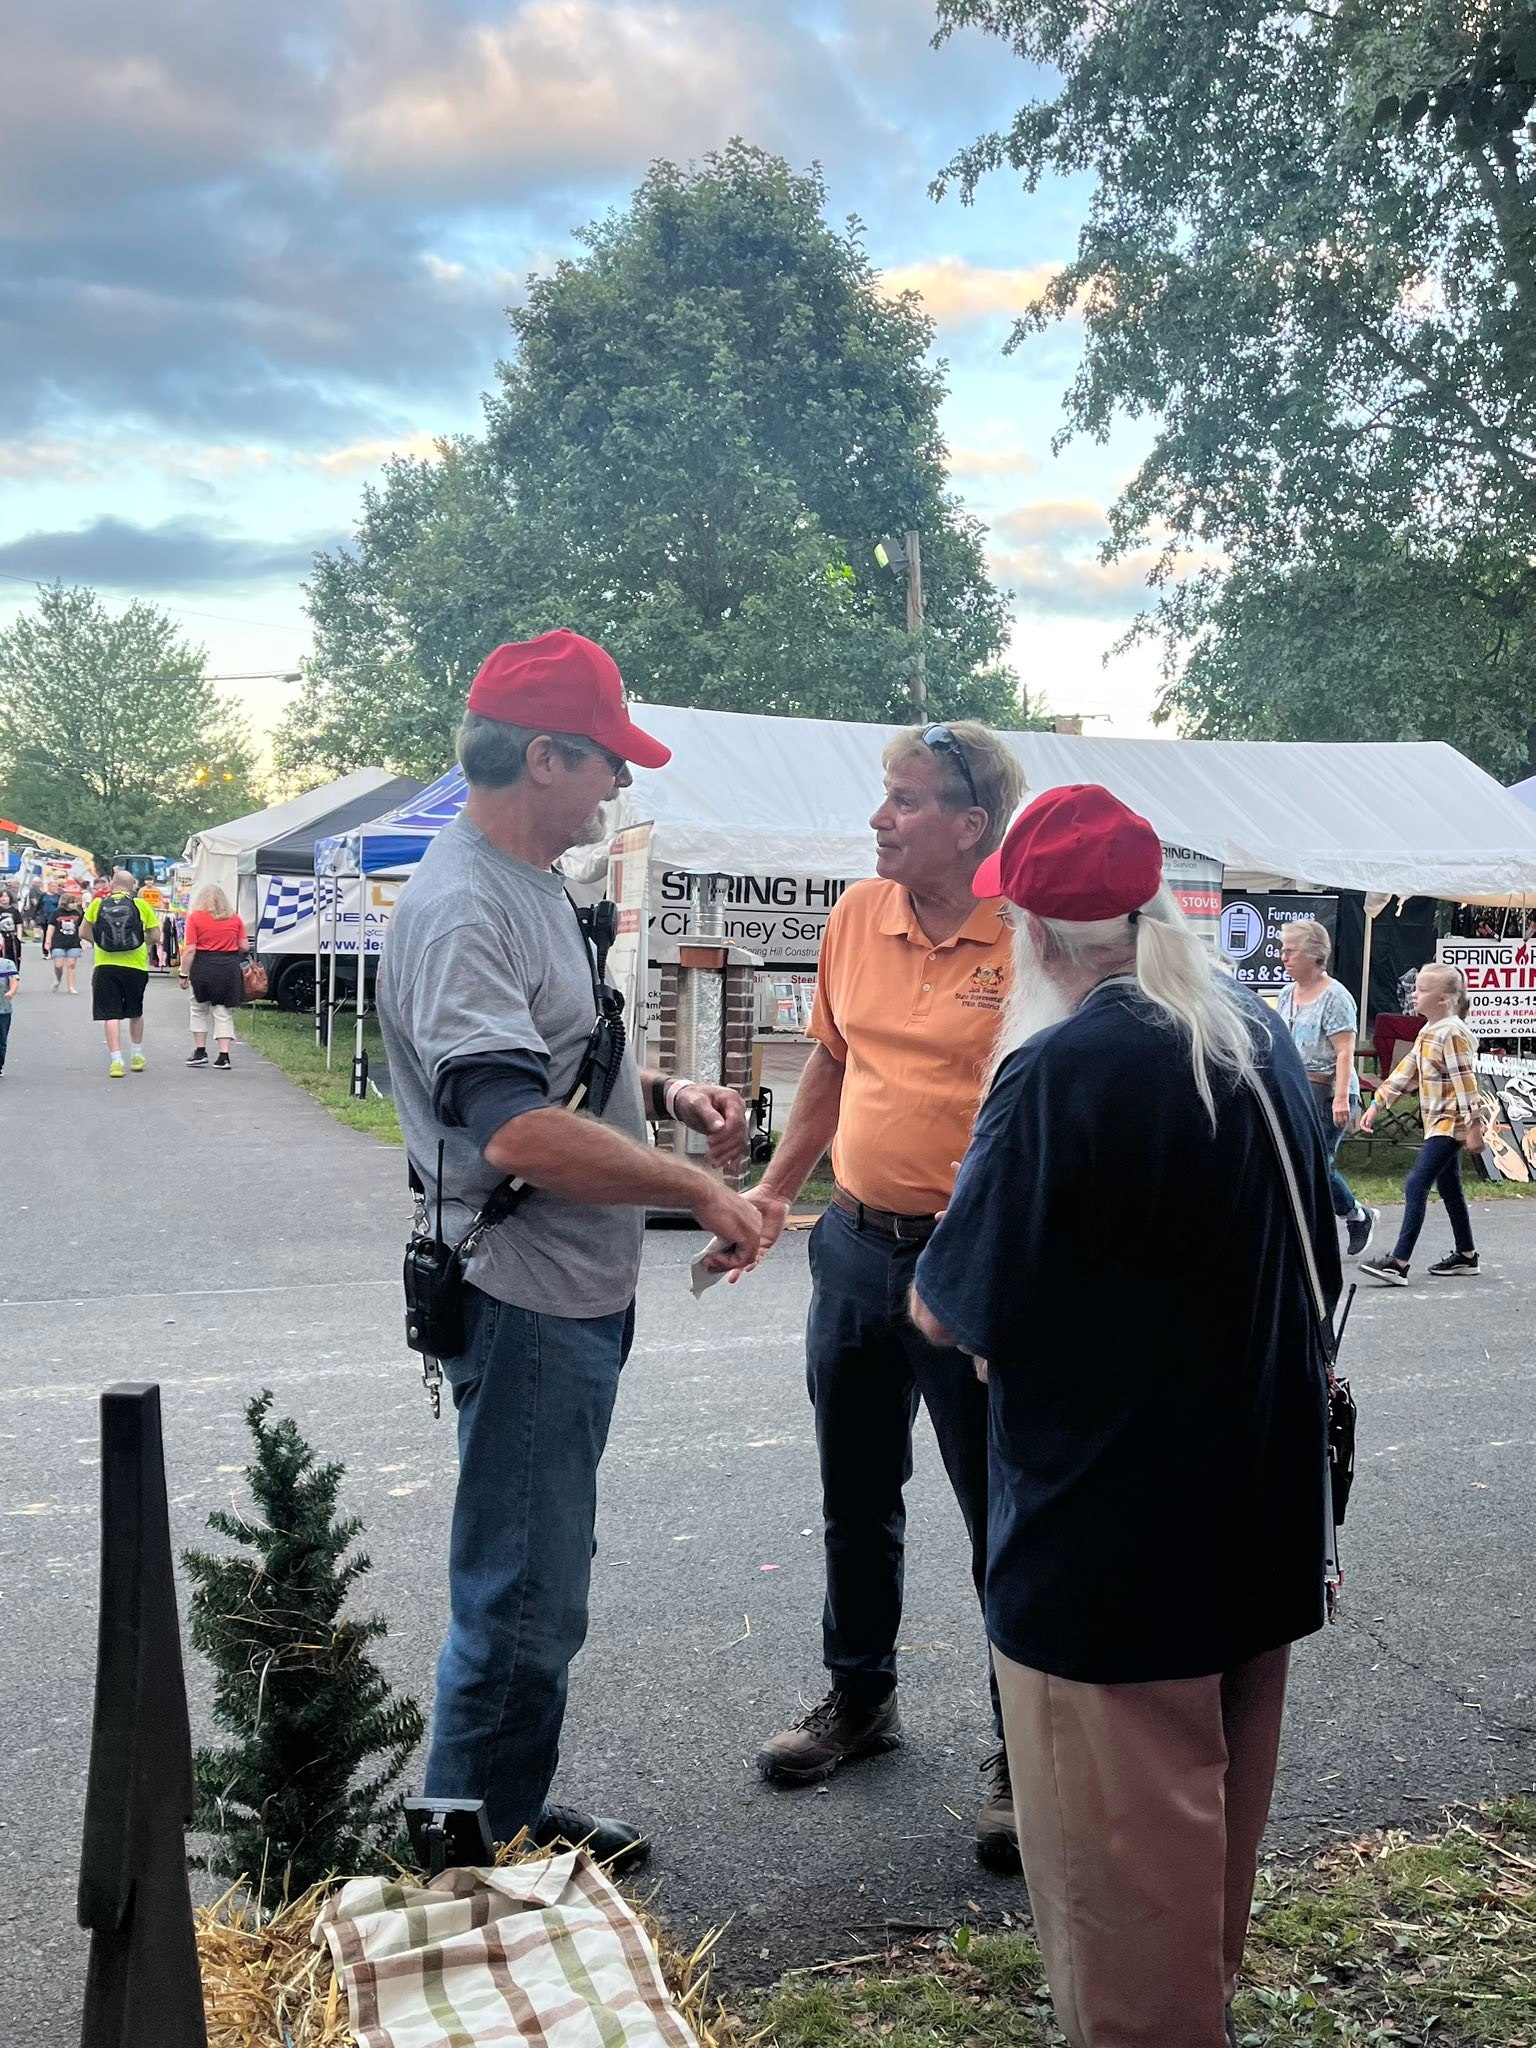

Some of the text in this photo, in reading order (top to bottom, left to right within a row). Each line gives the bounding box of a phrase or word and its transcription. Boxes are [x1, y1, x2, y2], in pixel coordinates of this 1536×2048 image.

[1182, 896, 1219, 909] STOVES
[1268, 907, 1315, 921] Furnaces
[661, 912, 777, 944] Chney
[1442, 949, 1513, 965] SPRING
[791, 975, 816, 984] Steel
[1258, 965, 1270, 981] &
